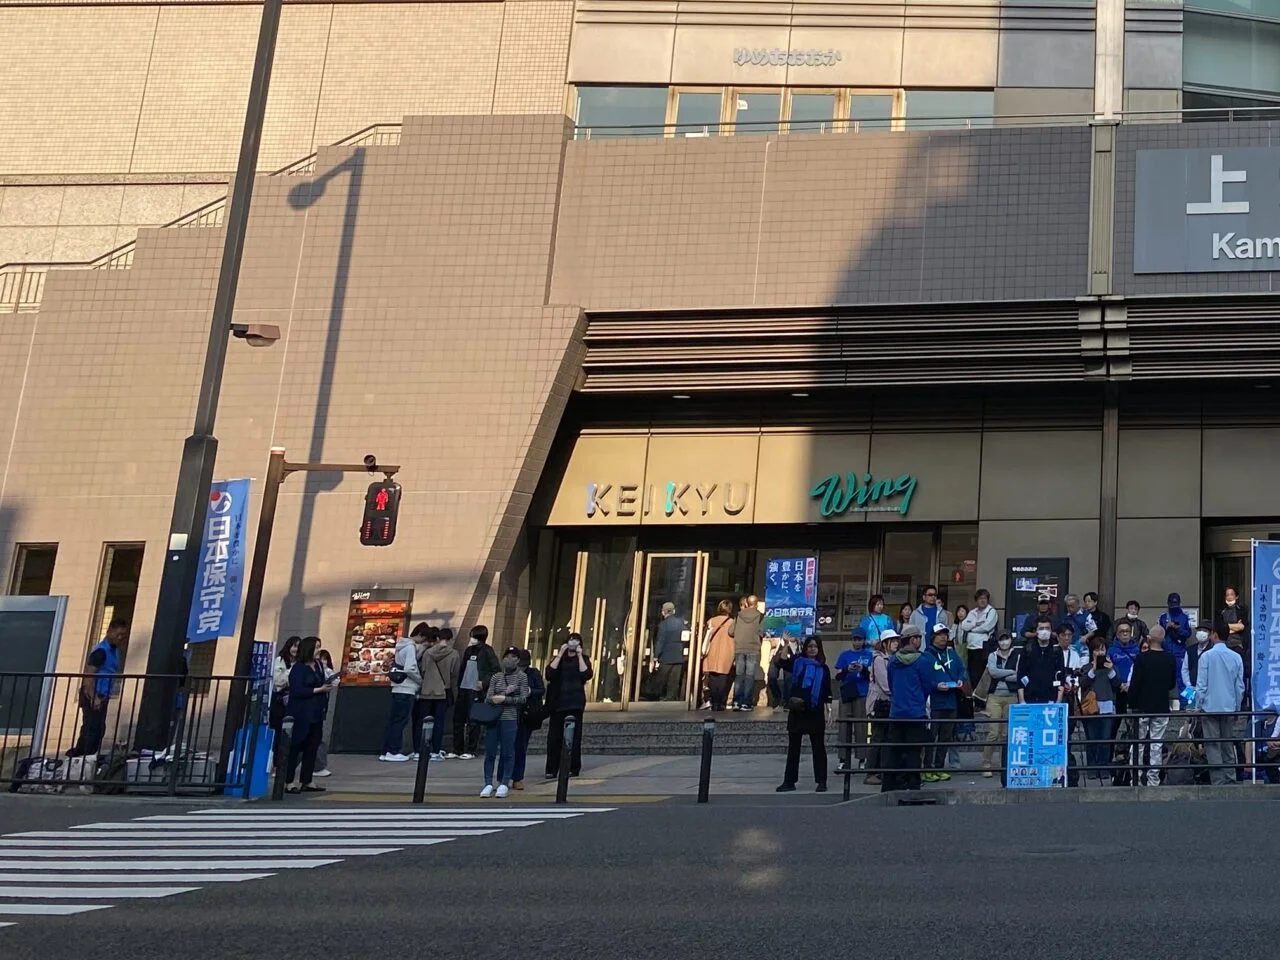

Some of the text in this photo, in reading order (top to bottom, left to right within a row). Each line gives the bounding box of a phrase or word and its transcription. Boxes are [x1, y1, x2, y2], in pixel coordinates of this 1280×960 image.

[586, 480, 751, 518] KEIKYU
[808, 471, 918, 517] Wing
[196, 515, 231, 634] 日本保守党
[793, 560, 804, 592] 日本を
[774, 607, 814, 617] 日本保守党
[1010, 726, 1029, 765] 廃止
